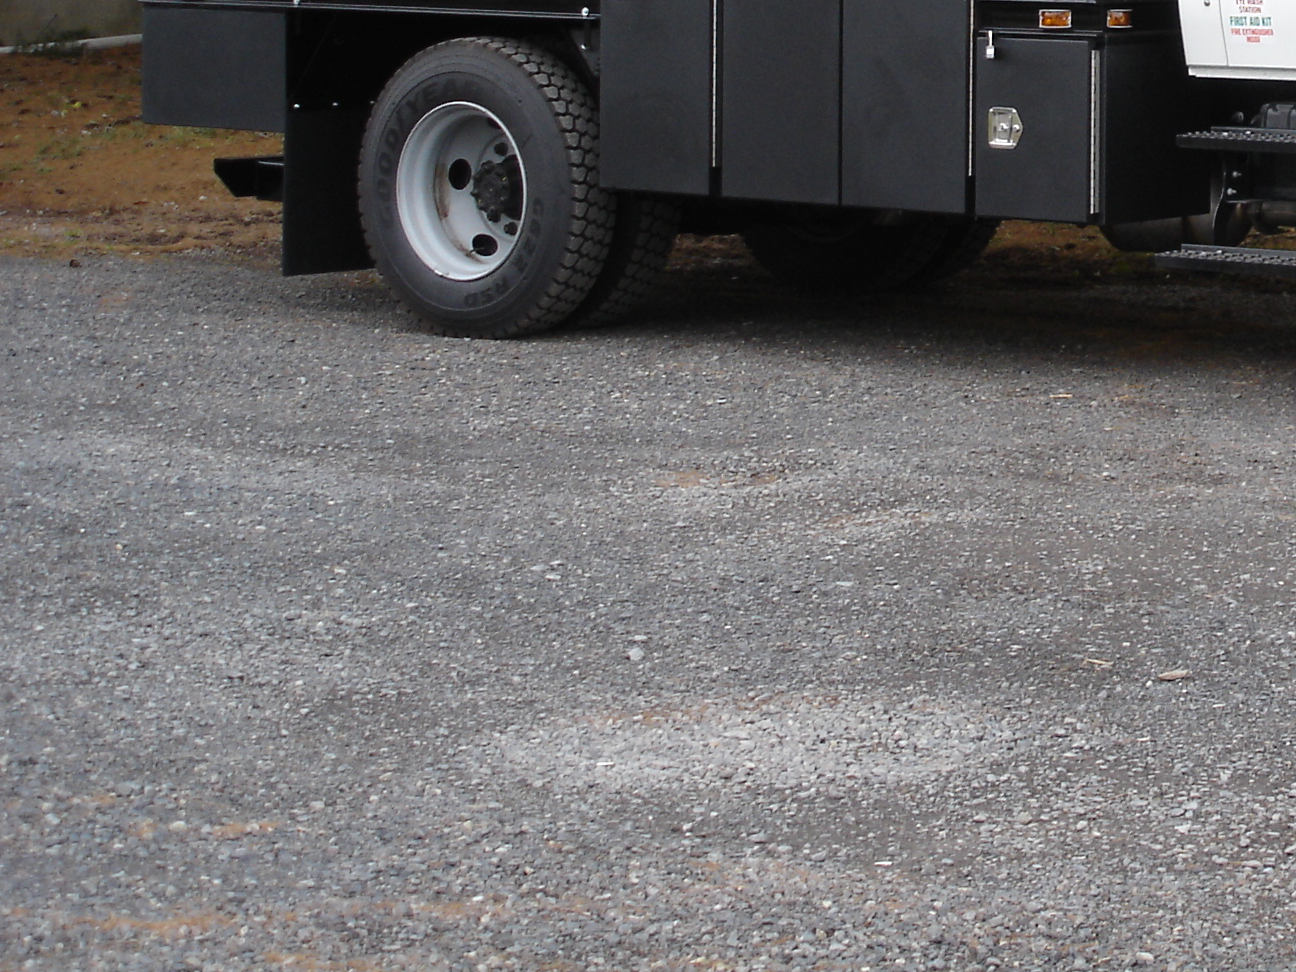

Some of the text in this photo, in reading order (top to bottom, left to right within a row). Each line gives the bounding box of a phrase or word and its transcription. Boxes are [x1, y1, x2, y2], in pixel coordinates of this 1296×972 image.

[1230, 16, 1271, 26] FIRST AID KIT
